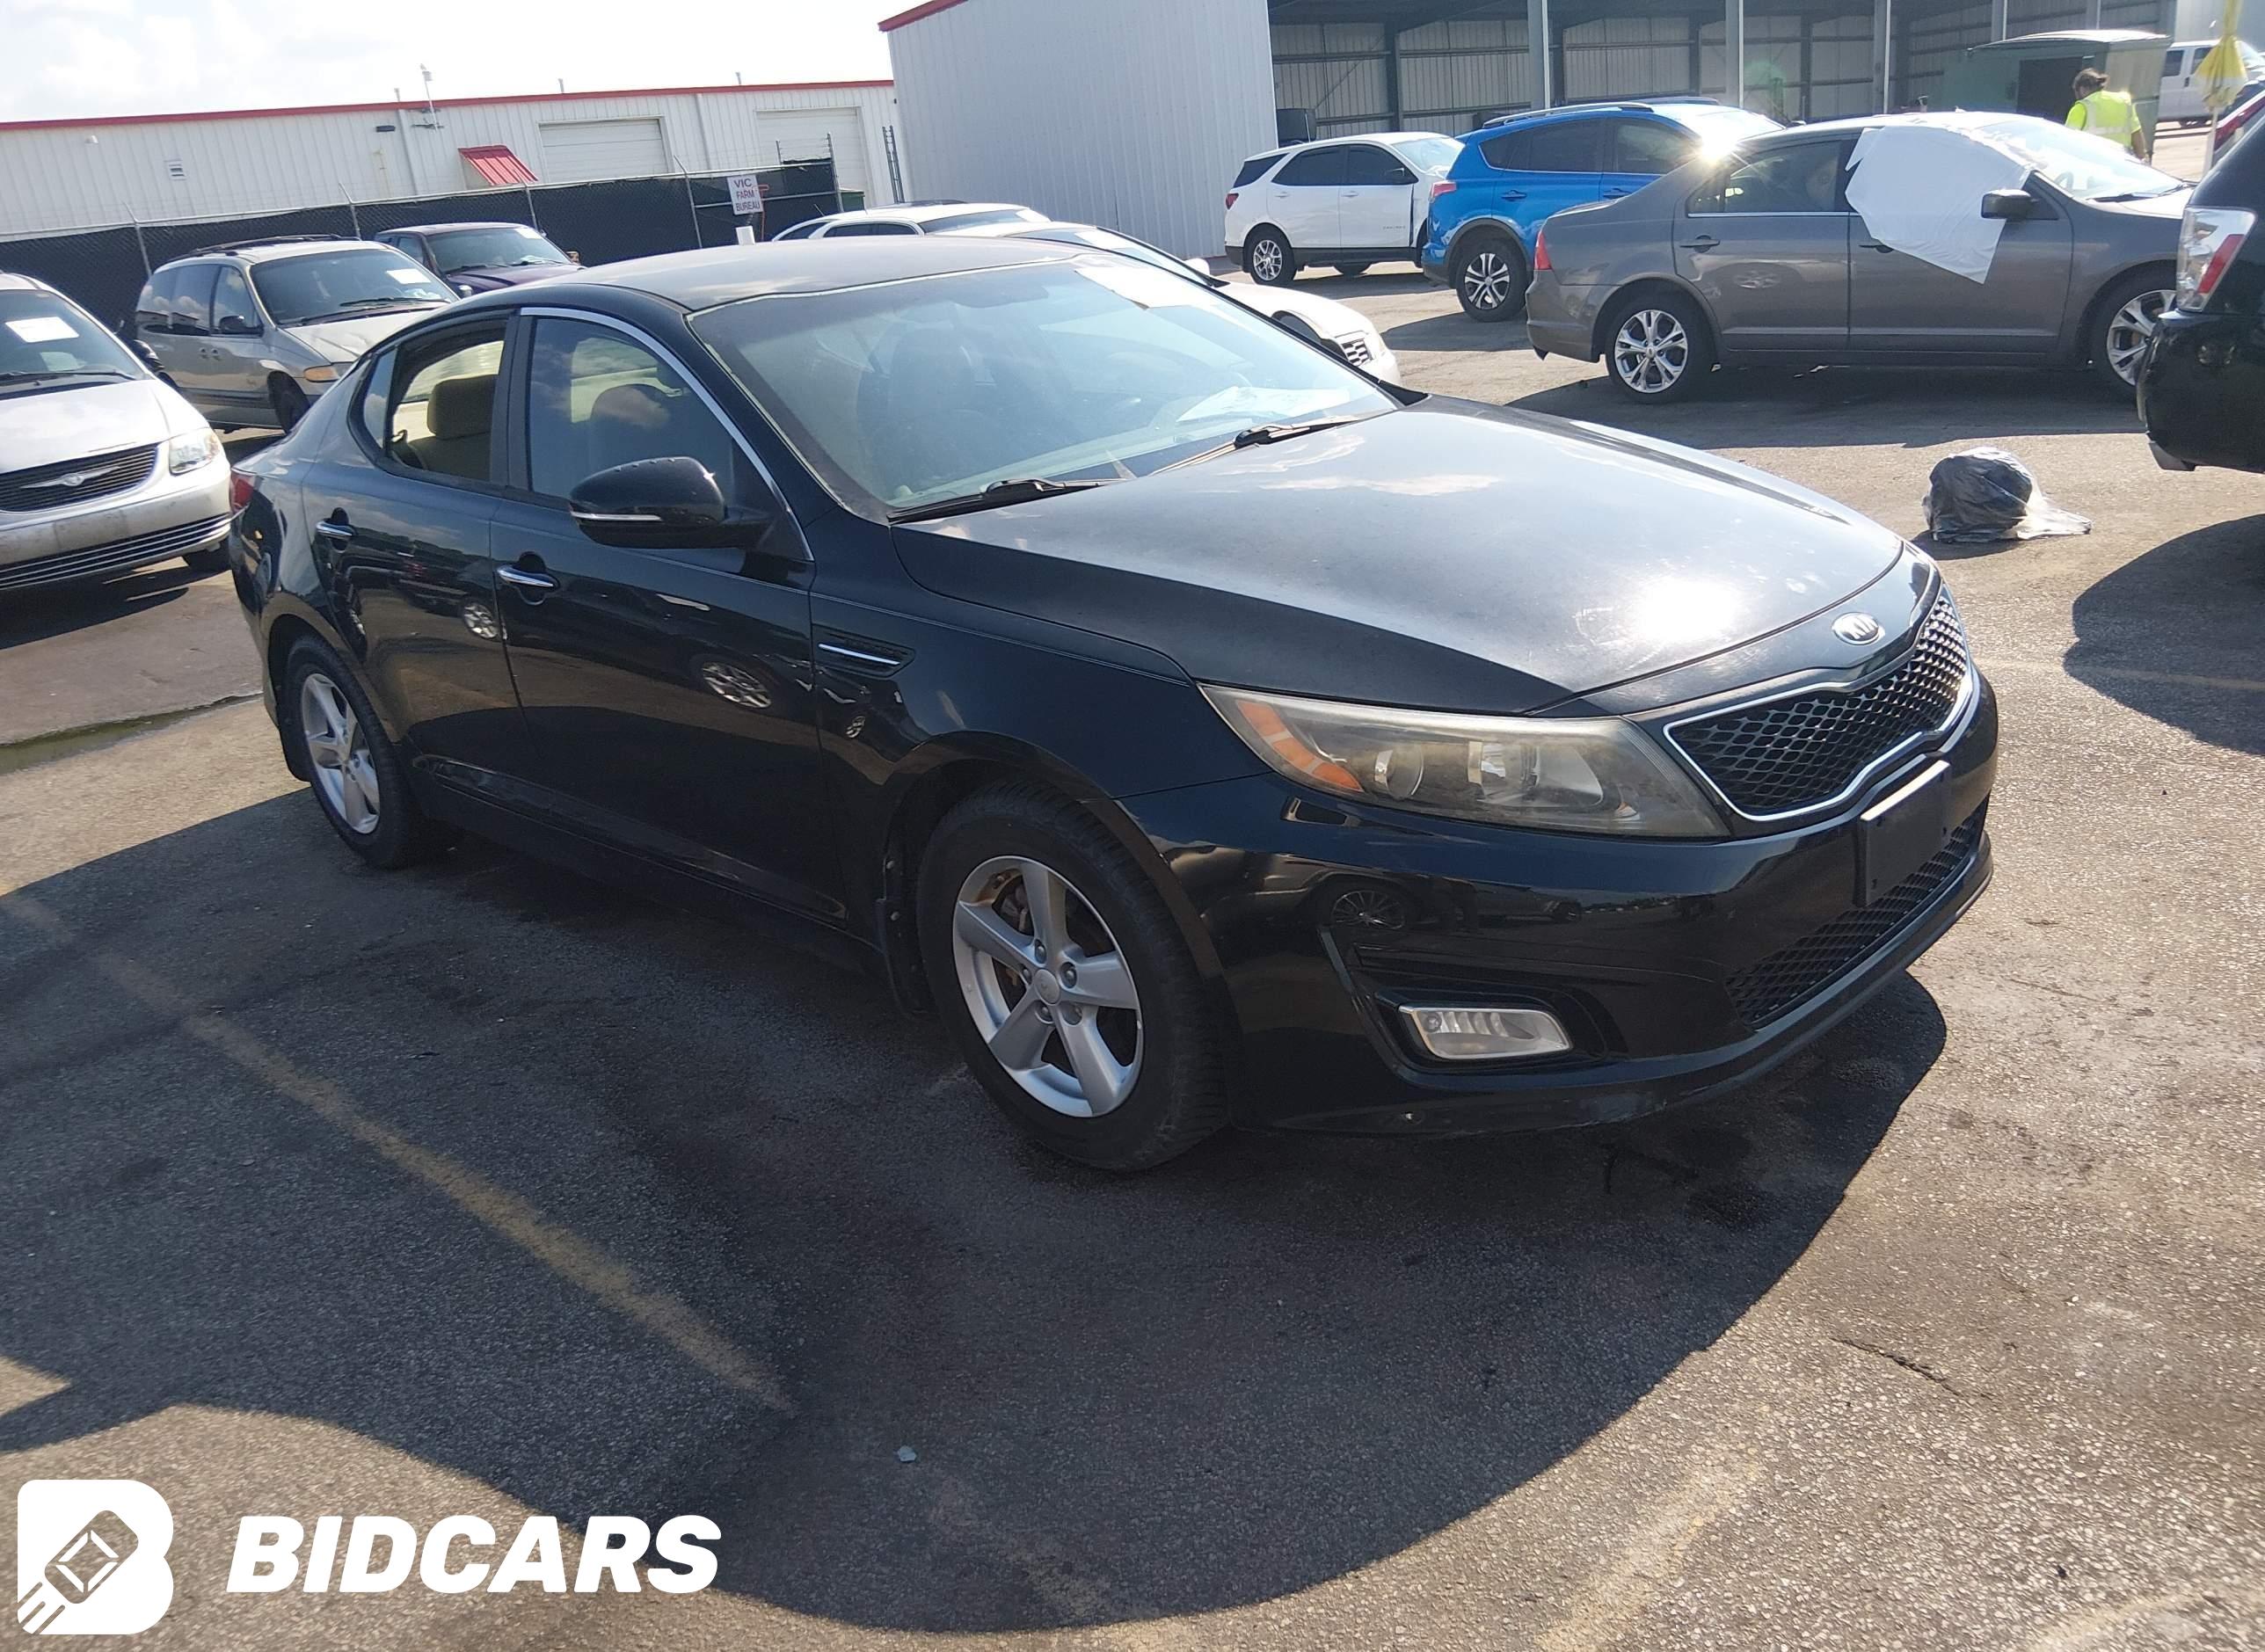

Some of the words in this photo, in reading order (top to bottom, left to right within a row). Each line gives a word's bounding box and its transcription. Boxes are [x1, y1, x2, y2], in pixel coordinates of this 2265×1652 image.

[733, 178, 753, 187] VIC
[736, 190, 755, 199] FARM
[735, 201, 760, 211] BUREAU
